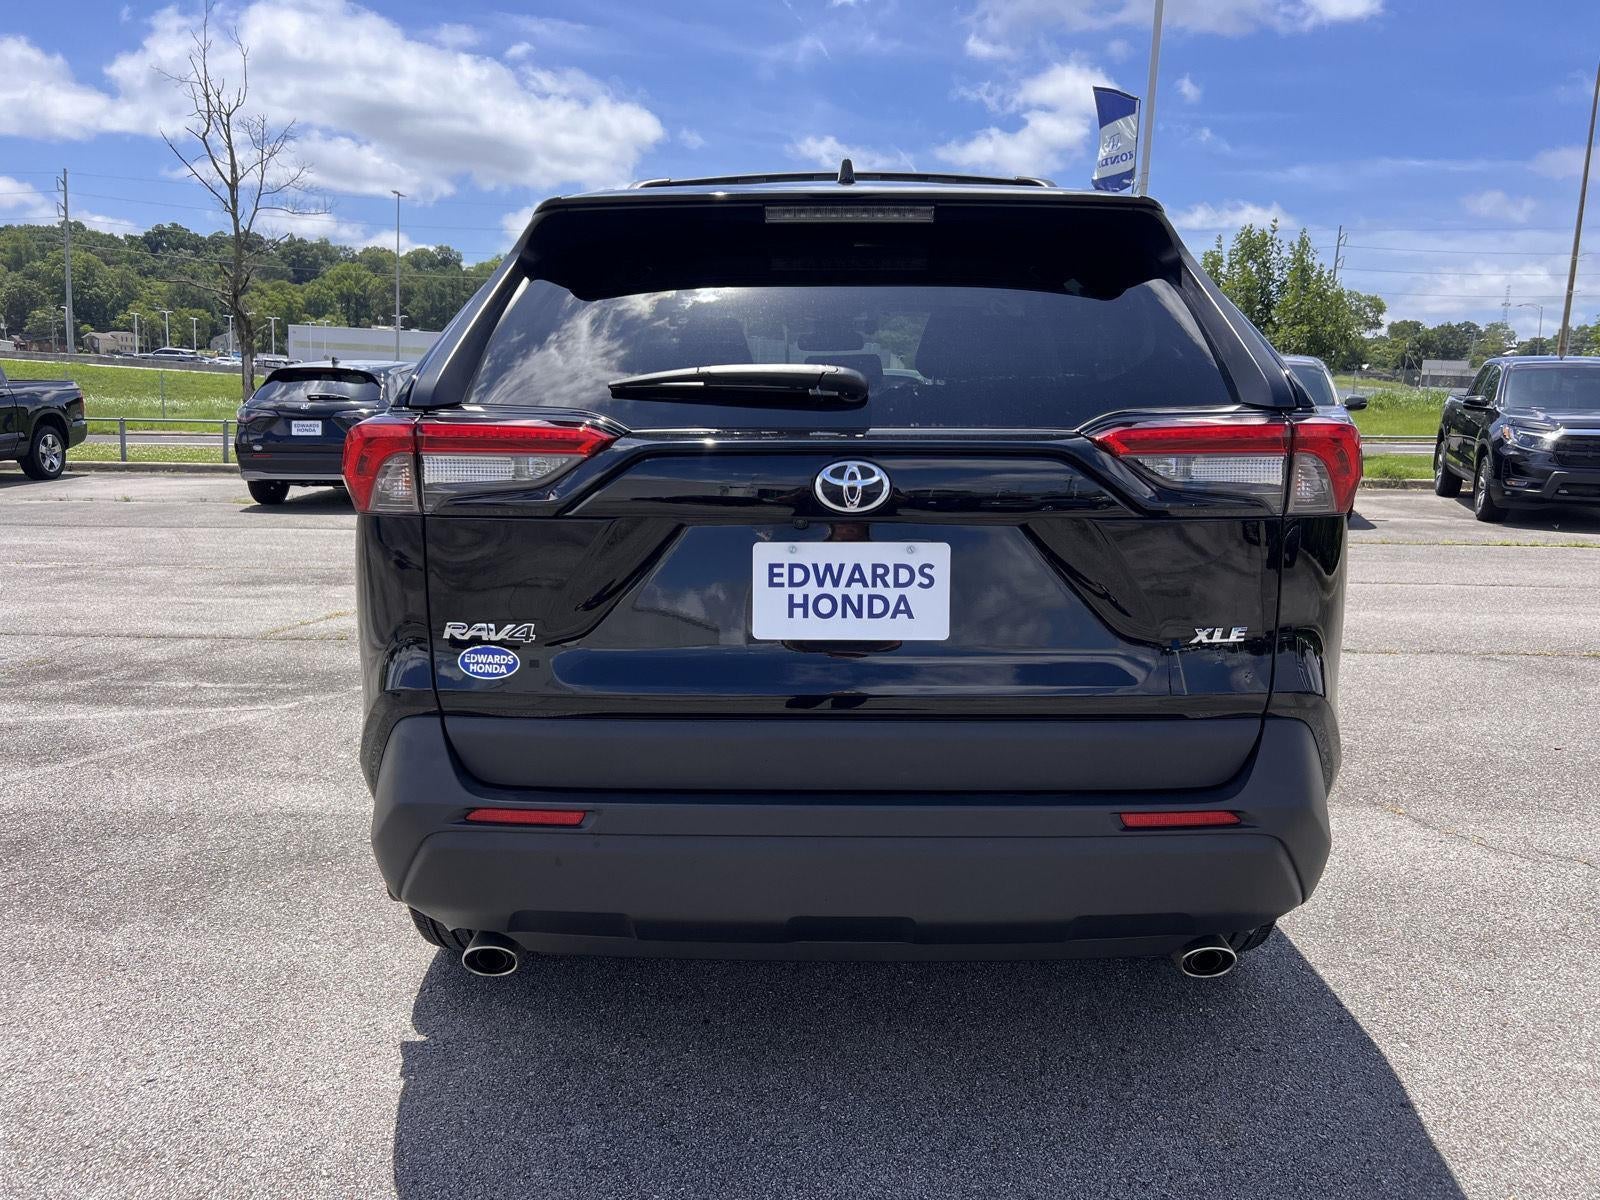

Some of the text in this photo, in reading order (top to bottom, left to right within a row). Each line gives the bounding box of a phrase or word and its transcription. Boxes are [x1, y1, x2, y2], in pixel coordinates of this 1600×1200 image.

[767, 563, 935, 589] EDWARDS
[787, 593, 915, 619] HONDA
[442, 622, 536, 643] RAV4
[1189, 626, 1248, 643] XLE
[464, 653, 514, 664] EDWARDS
[469, 663, 508, 674] HONDA
